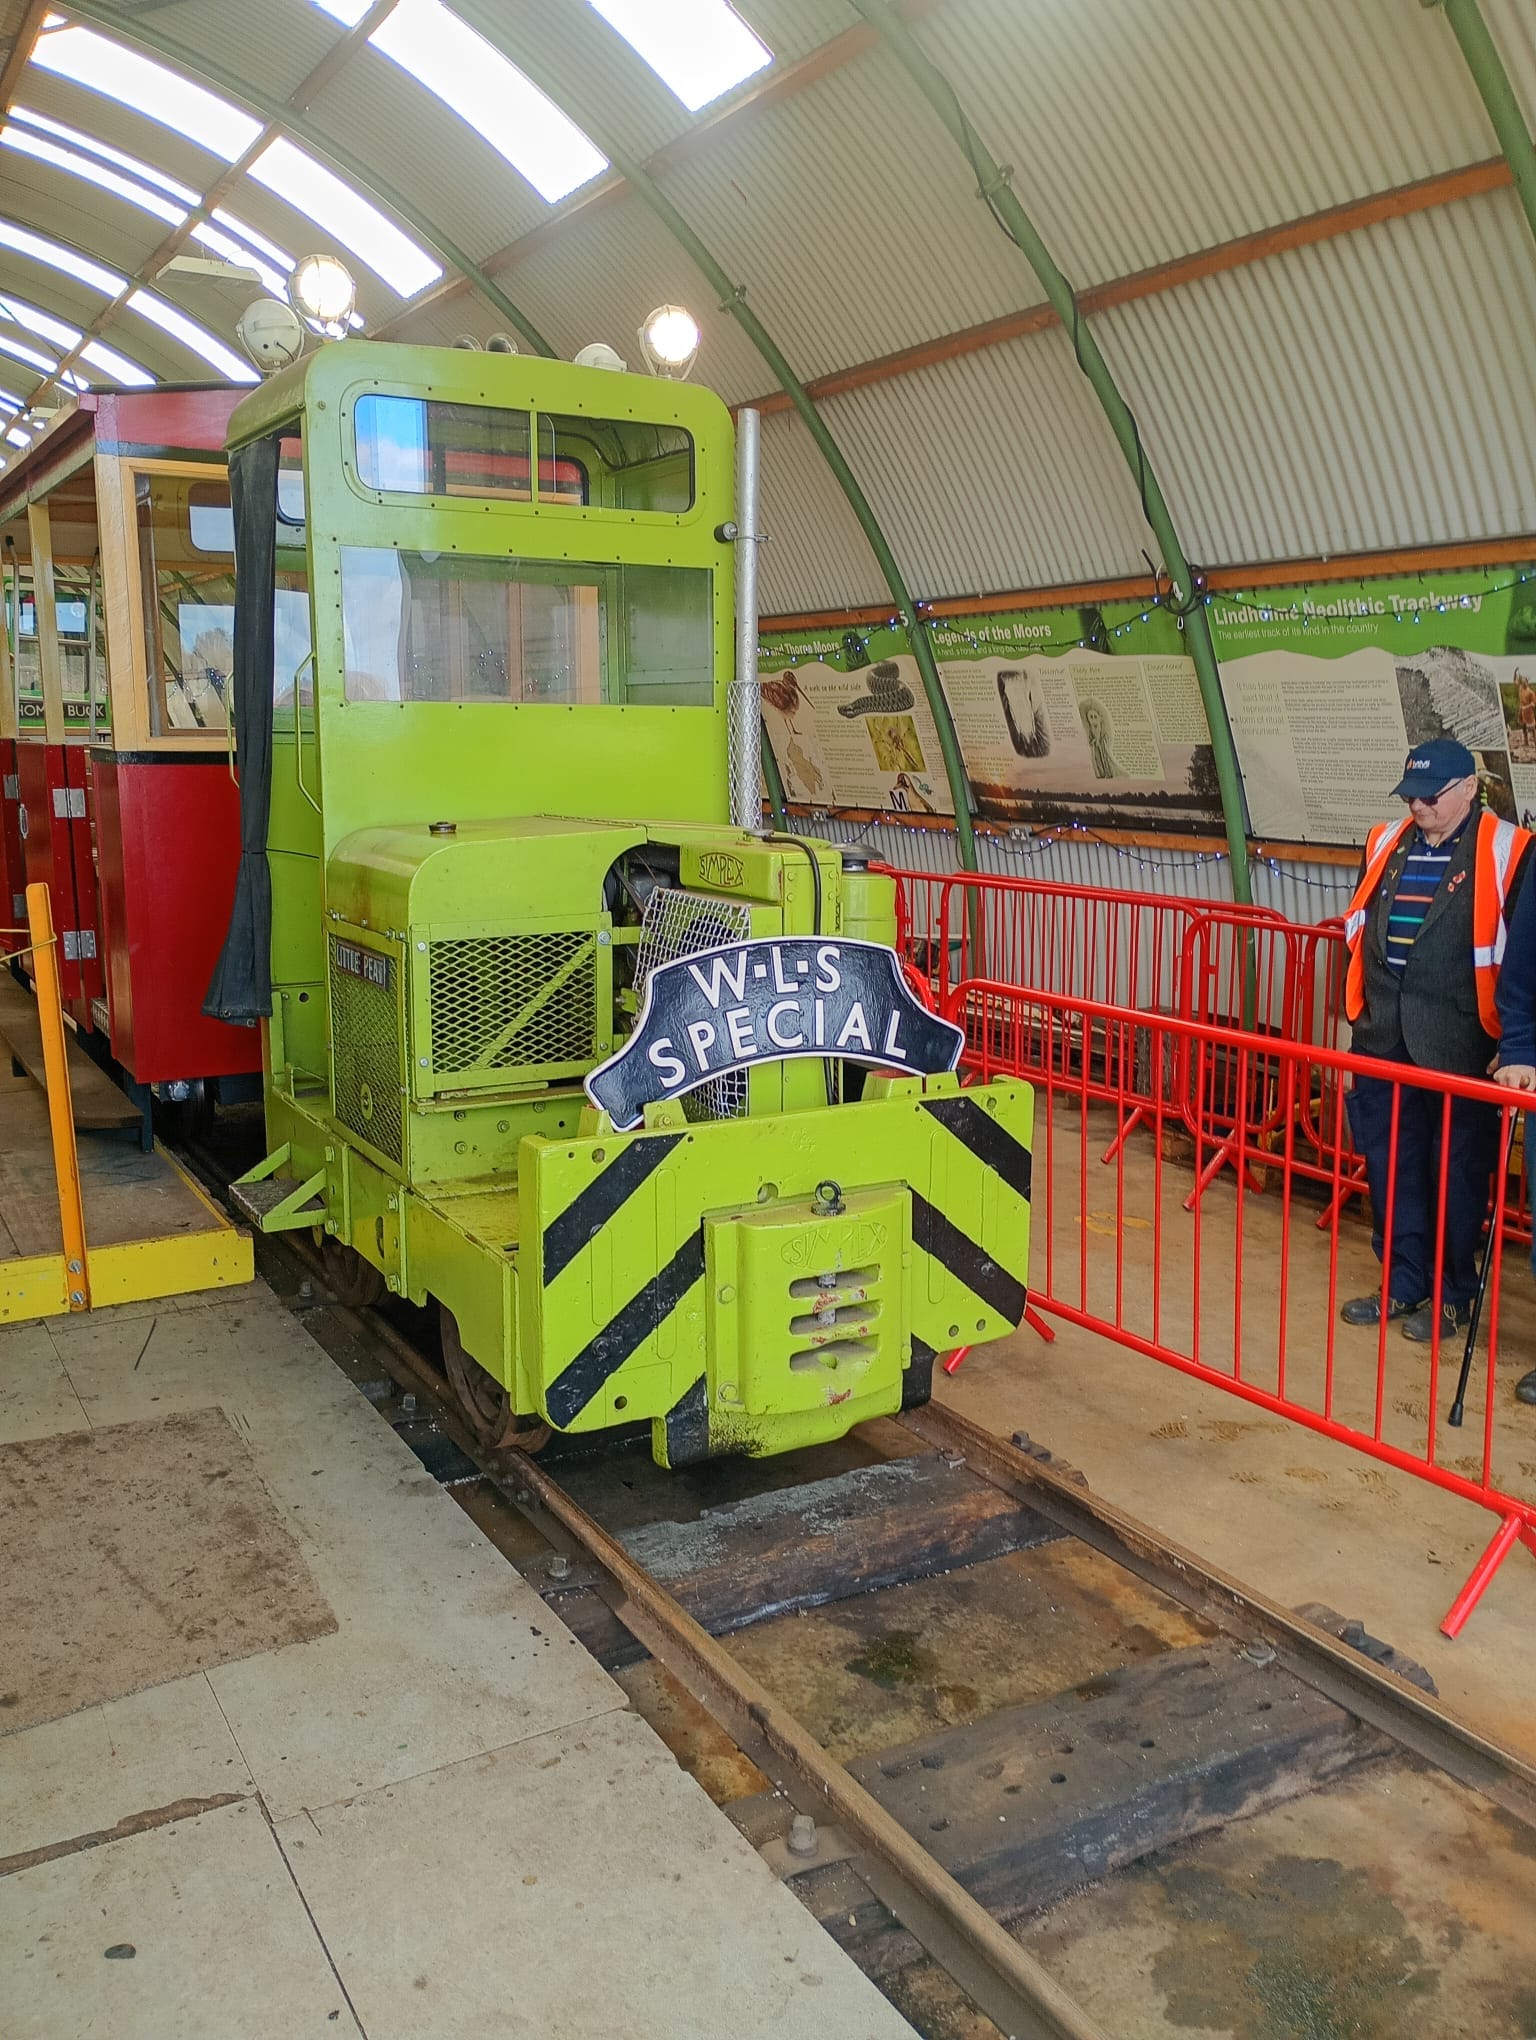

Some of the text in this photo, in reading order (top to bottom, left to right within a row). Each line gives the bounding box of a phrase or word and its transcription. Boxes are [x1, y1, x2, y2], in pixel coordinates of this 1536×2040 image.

[899, 609, 909, 627] 5
[1213, 592, 1483, 626] Lindholme Neolithic Trackway
[931, 624, 1052, 646] Legends of the Moors
[1218, 630, 1232, 640] The
[1233, 628, 1260, 639] earliest
[1262, 627, 1281, 638] track
[1282, 626, 1290, 637] of
[1302, 624, 1320, 636] kind
[1322, 625, 1330, 635] in
[1331, 624, 1345, 634] the
[1346, 623, 1378, 634] country
[813, 640, 840, 654] Moors
[699, 855, 744, 885] SIMPLEX
[336, 943, 384, 985] LITTLE PEAT
[648, 999, 908, 1088] SPECIAL
